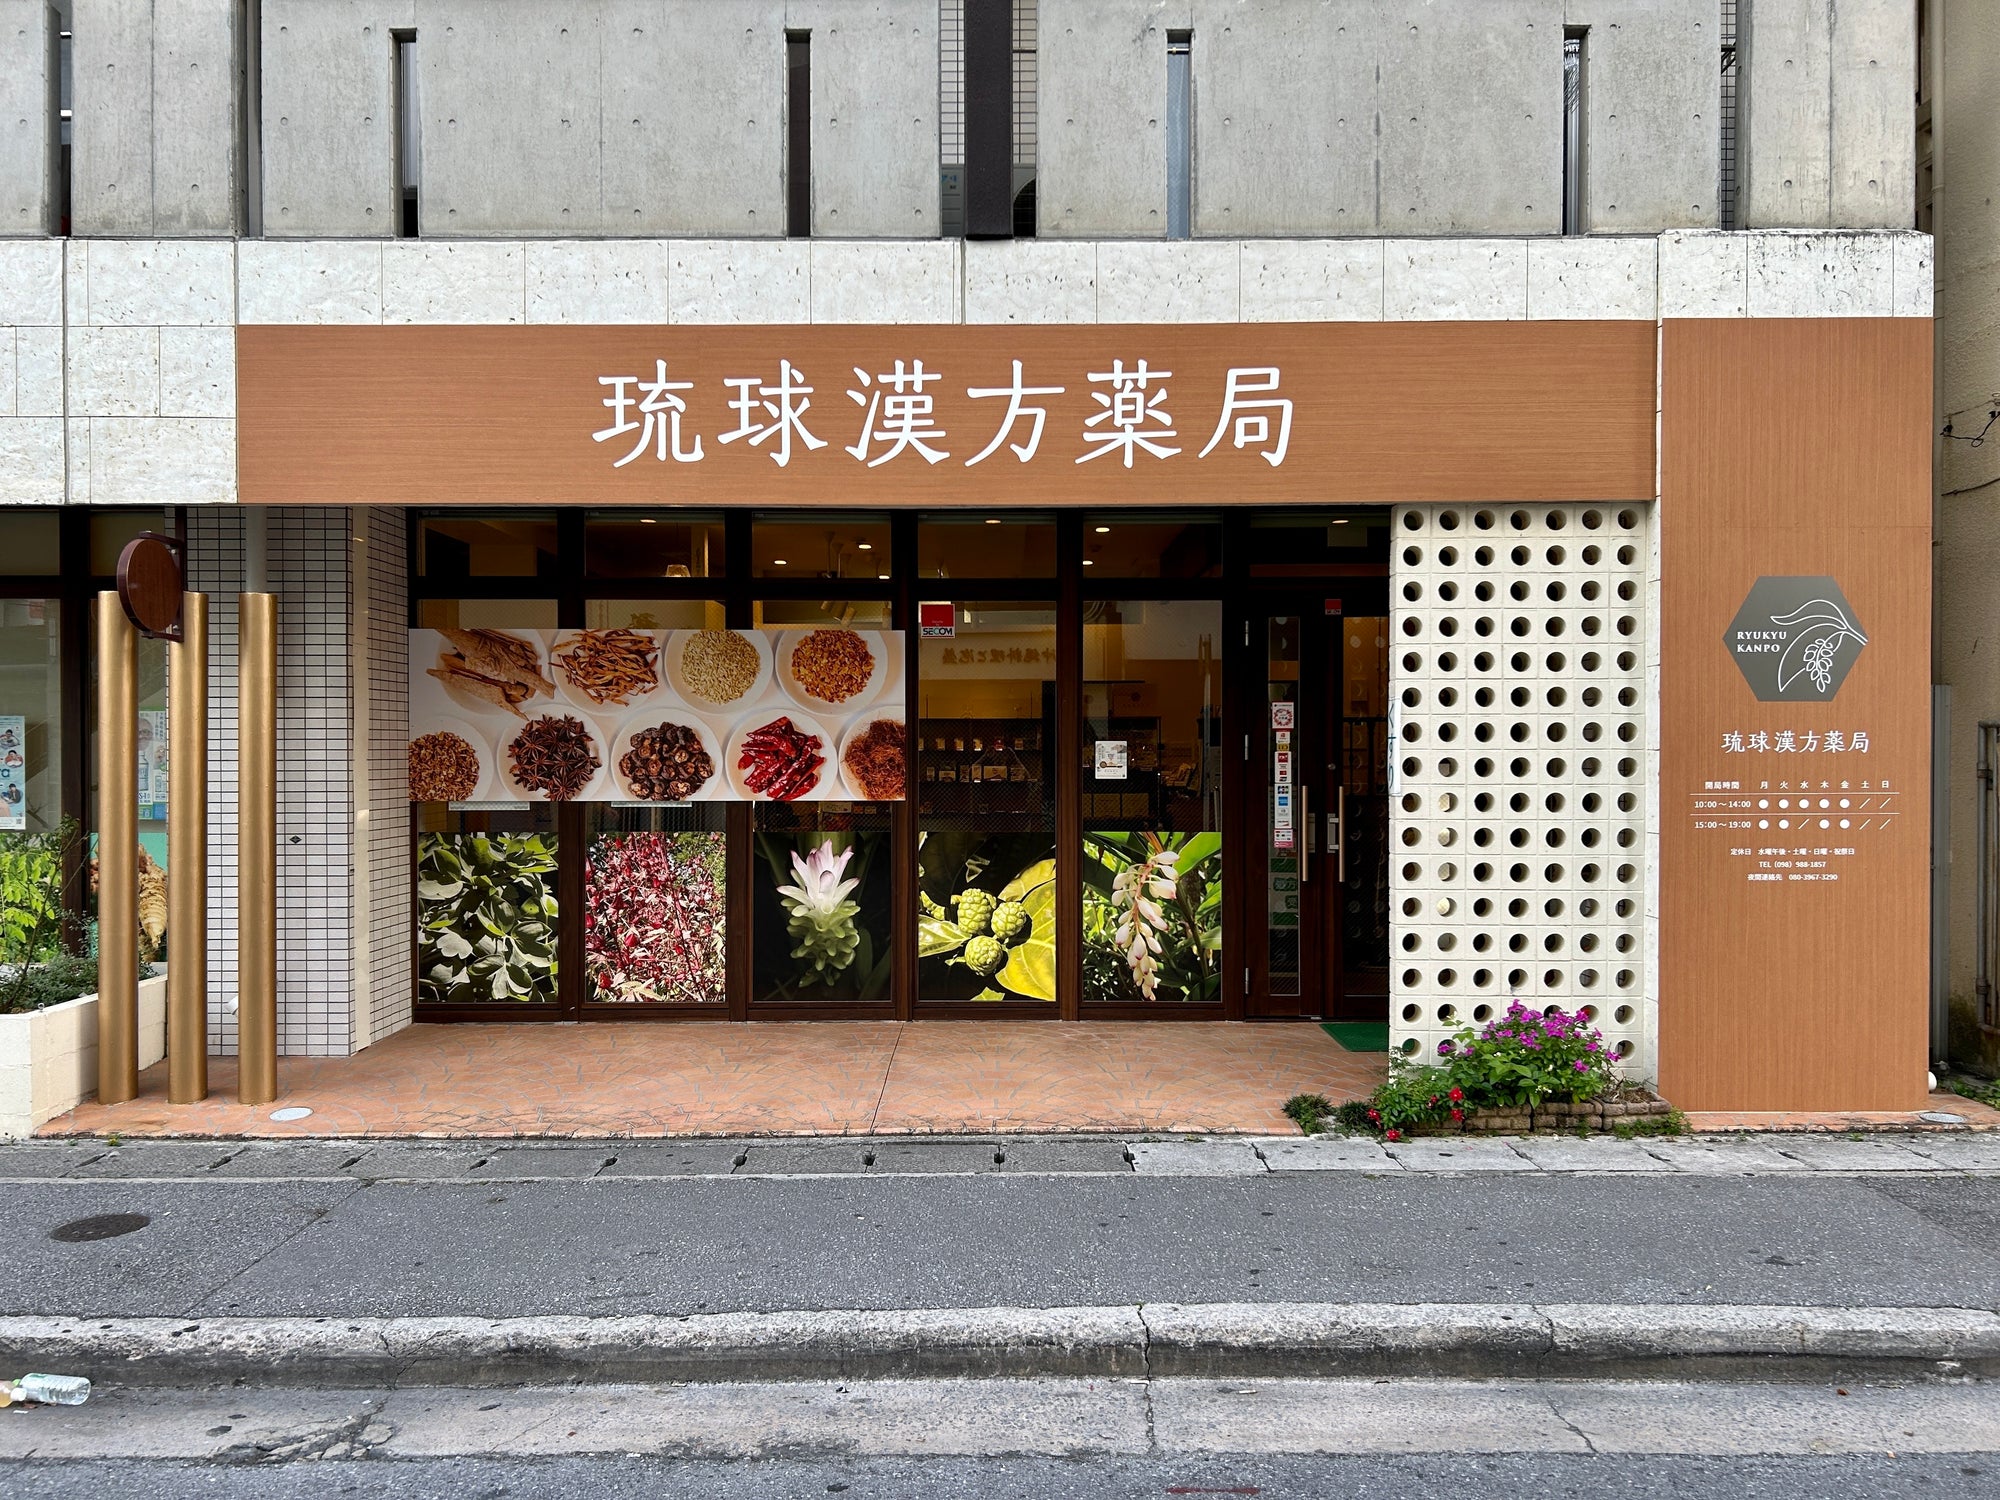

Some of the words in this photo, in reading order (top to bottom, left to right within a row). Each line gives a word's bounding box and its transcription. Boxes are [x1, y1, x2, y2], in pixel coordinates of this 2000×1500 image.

[591, 359, 1293, 468] 琉球漢方薬局
[923, 627, 953, 636] SECOM
[1737, 631, 1787, 640] RYUKYU
[1737, 643, 1781, 653] KANPO
[1720, 730, 1870, 754] 琉球漢方薬局
[1704, 781, 1740, 790] 開局時間
[1760, 780, 1769, 790] 月
[1780, 780, 1789, 790] 火
[1800, 780, 1809, 790] 水
[1820, 780, 1829, 790] 木
[1841, 780, 1849, 790] 金
[1861, 780, 1870, 790] 土
[1881, 780, 1890, 790] 日
[1730, 847, 1752, 856] 定休日
